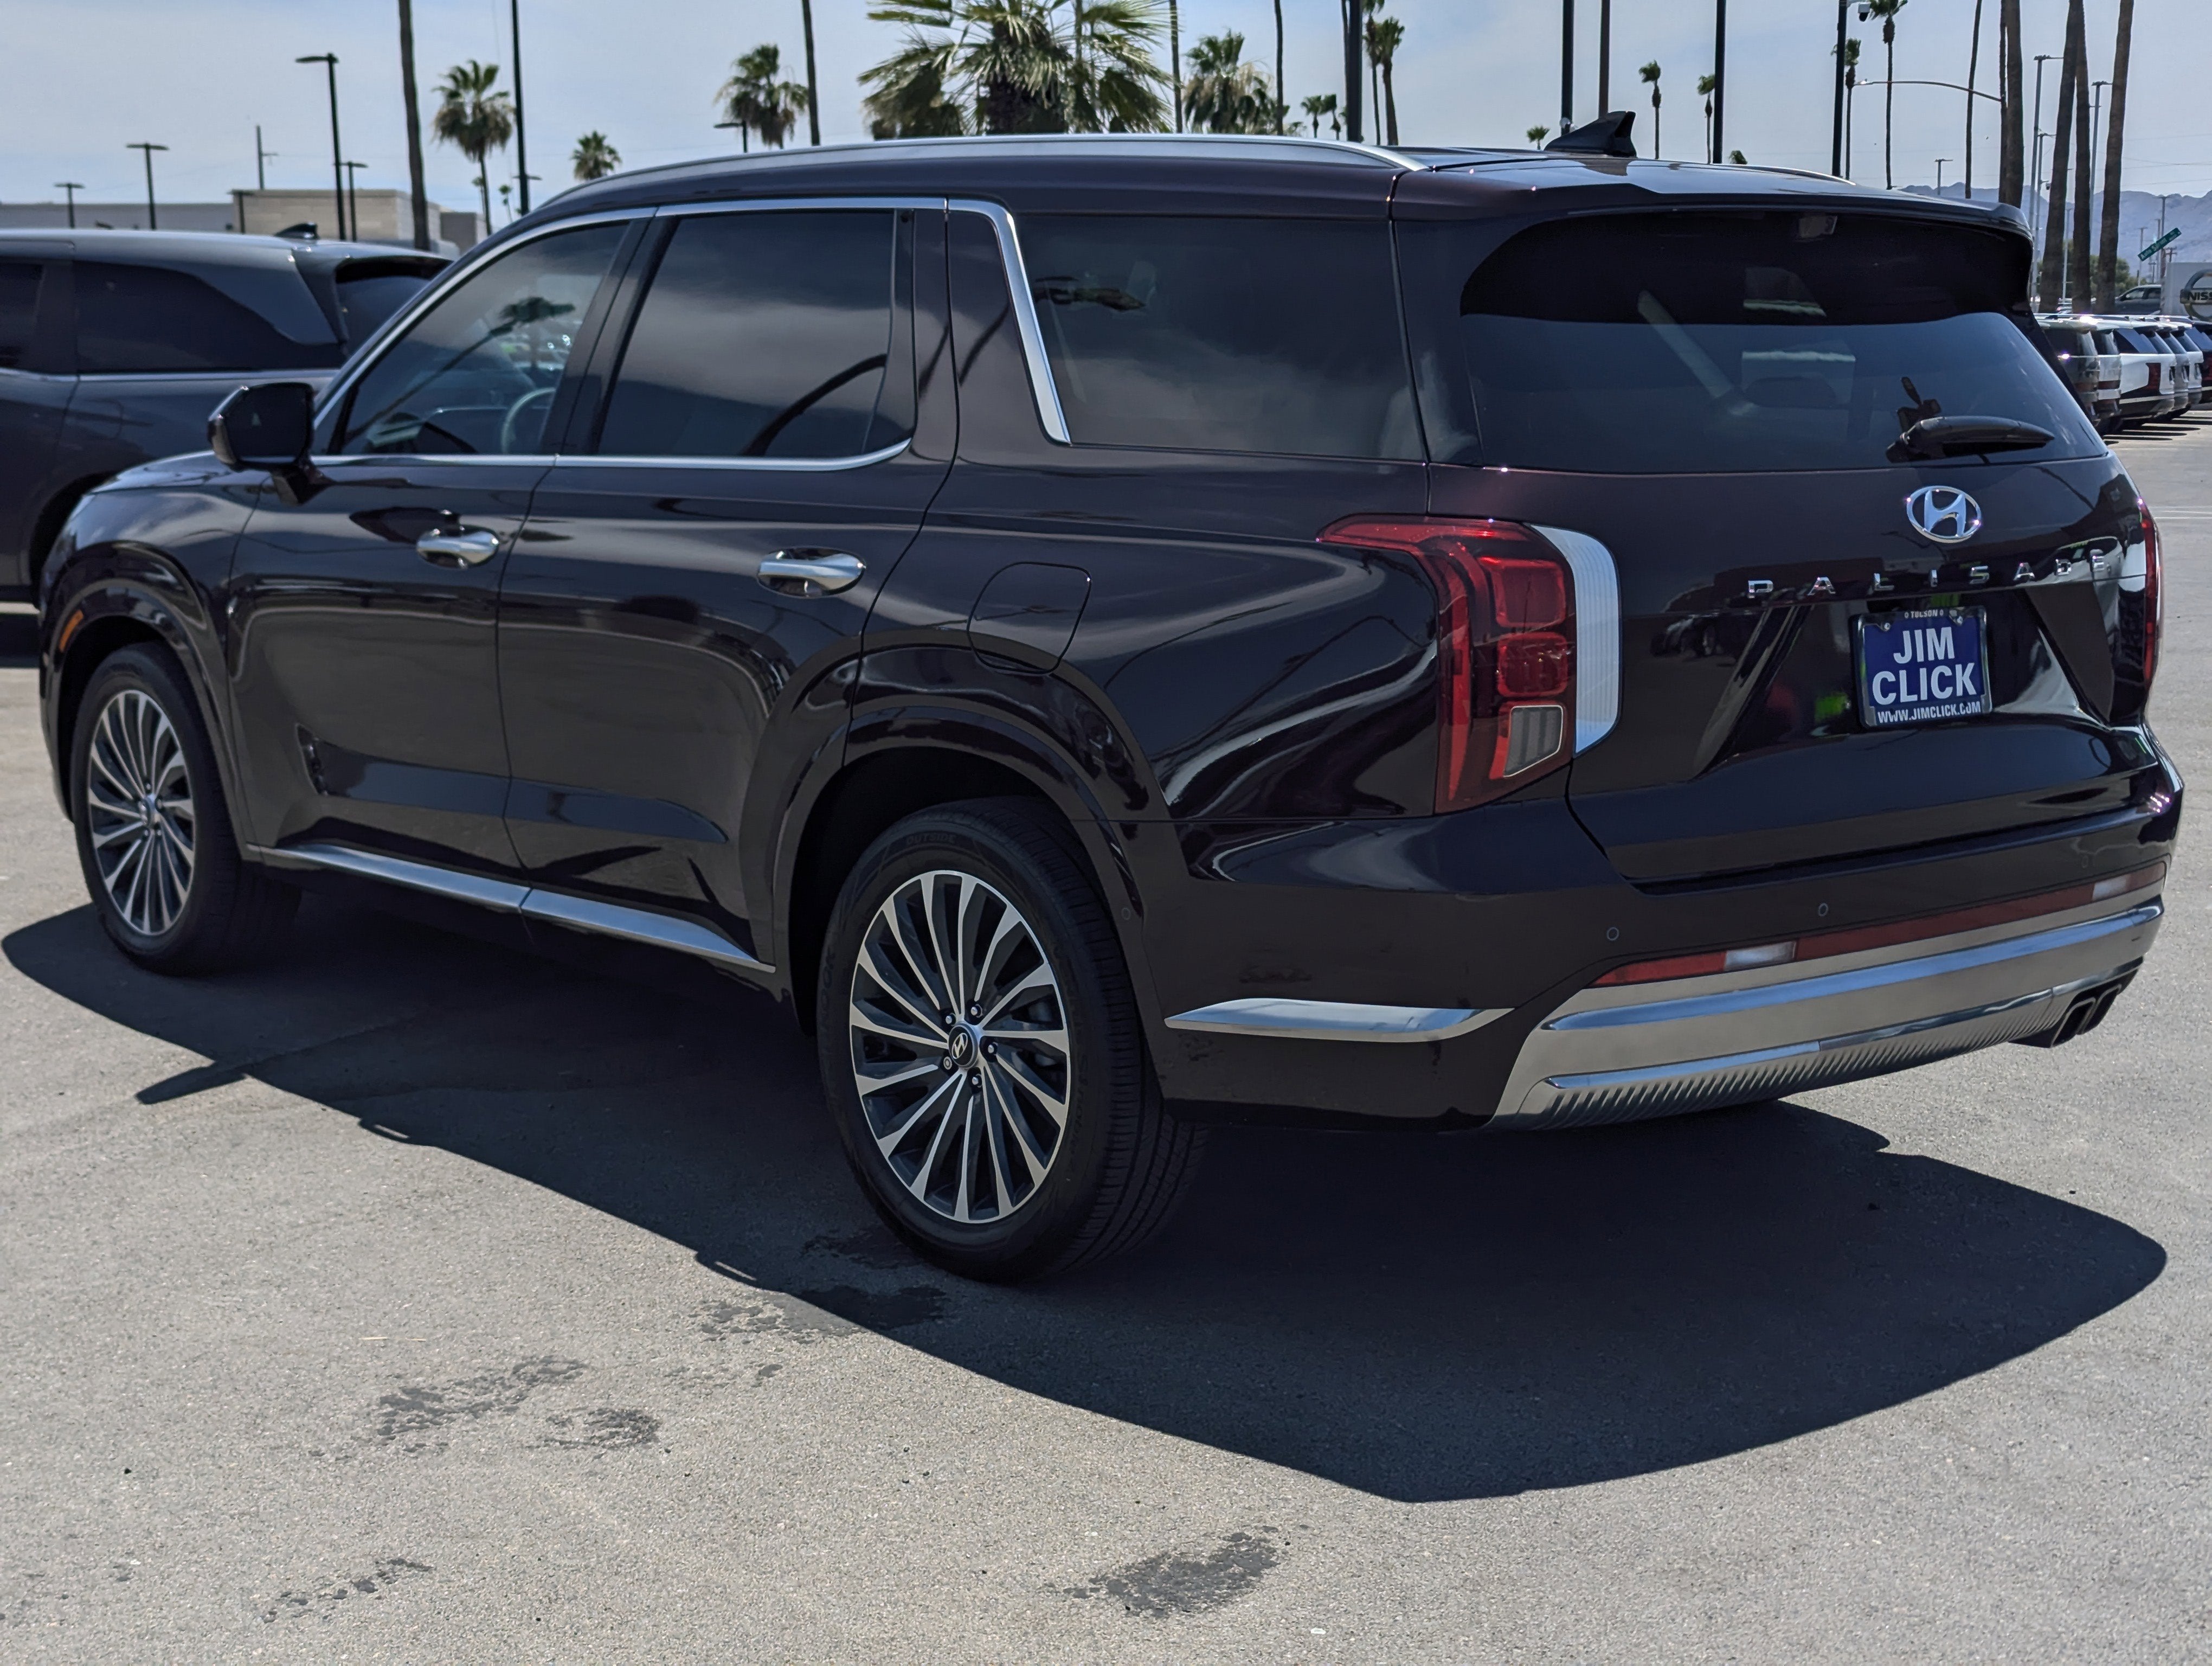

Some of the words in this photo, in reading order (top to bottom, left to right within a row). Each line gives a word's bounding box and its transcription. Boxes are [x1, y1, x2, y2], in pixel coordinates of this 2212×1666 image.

[1747, 549, 2105, 599] PALISADE
[1893, 626, 1955, 664] JIM
[1872, 662, 1977, 706] CLICK
[1877, 701, 1982, 724] WWW.JIMCLICK.COM
